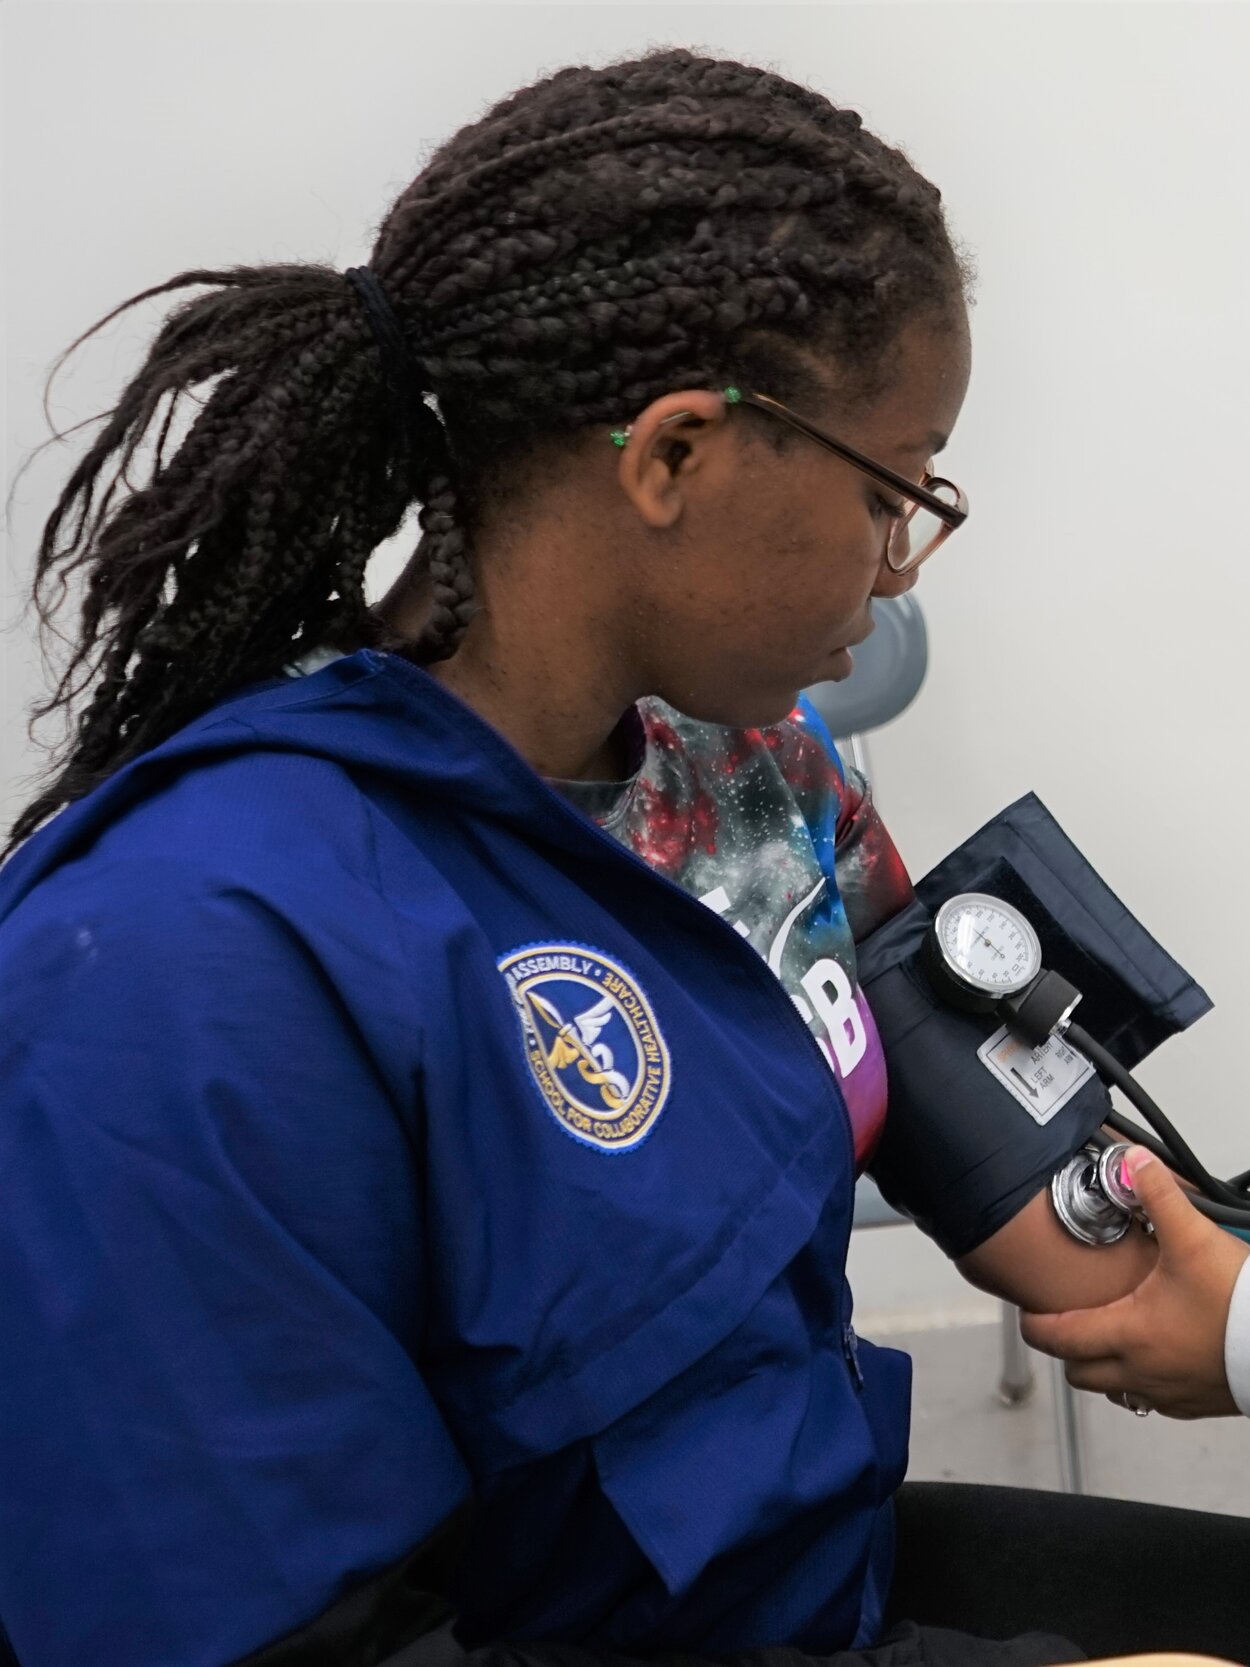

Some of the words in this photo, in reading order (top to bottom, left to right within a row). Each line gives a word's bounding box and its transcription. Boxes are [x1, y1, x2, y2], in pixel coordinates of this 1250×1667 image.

[510, 956, 593, 981] ASSEMBLY
[602, 973, 661, 1064] HEALTHCARE
[531, 1050, 566, 1115] SCHOOL
[1030, 1066, 1048, 1083] LEFT
[1039, 1073, 1055, 1090] ARM
[593, 1065, 662, 1140] COLLABORATIVE
[567, 1109, 593, 1132] FOR
